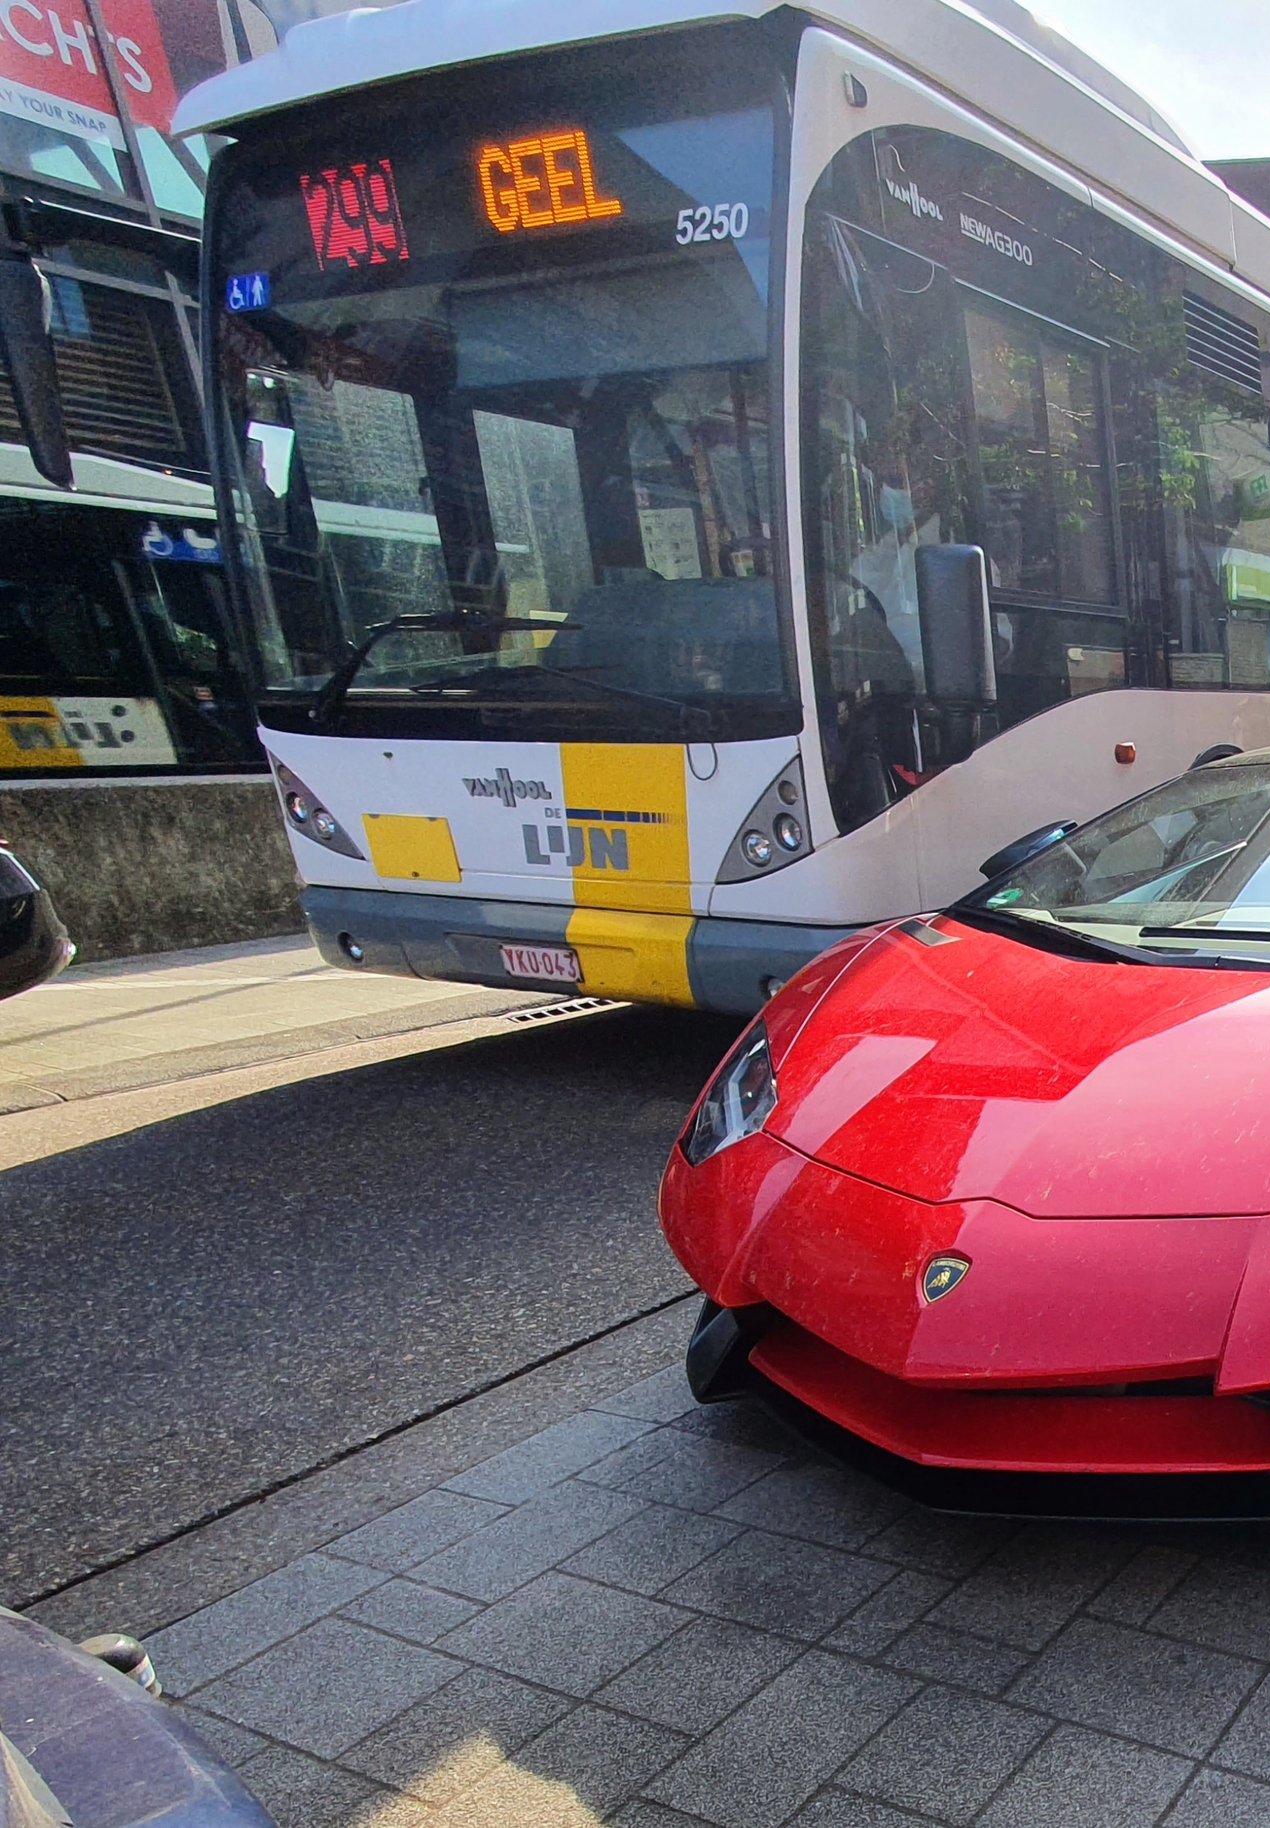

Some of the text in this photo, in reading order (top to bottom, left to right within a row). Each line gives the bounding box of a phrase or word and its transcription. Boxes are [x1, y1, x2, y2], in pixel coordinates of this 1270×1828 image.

[18, 94, 65, 119] YOUR
[67, 110, 107, 133] SNAP
[478, 130, 623, 234] GEEL
[300, 158, 410, 272] 299
[675, 202, 749, 246] 5250
[544, 807, 562, 819] DE
[521, 824, 629, 870] LIJN
